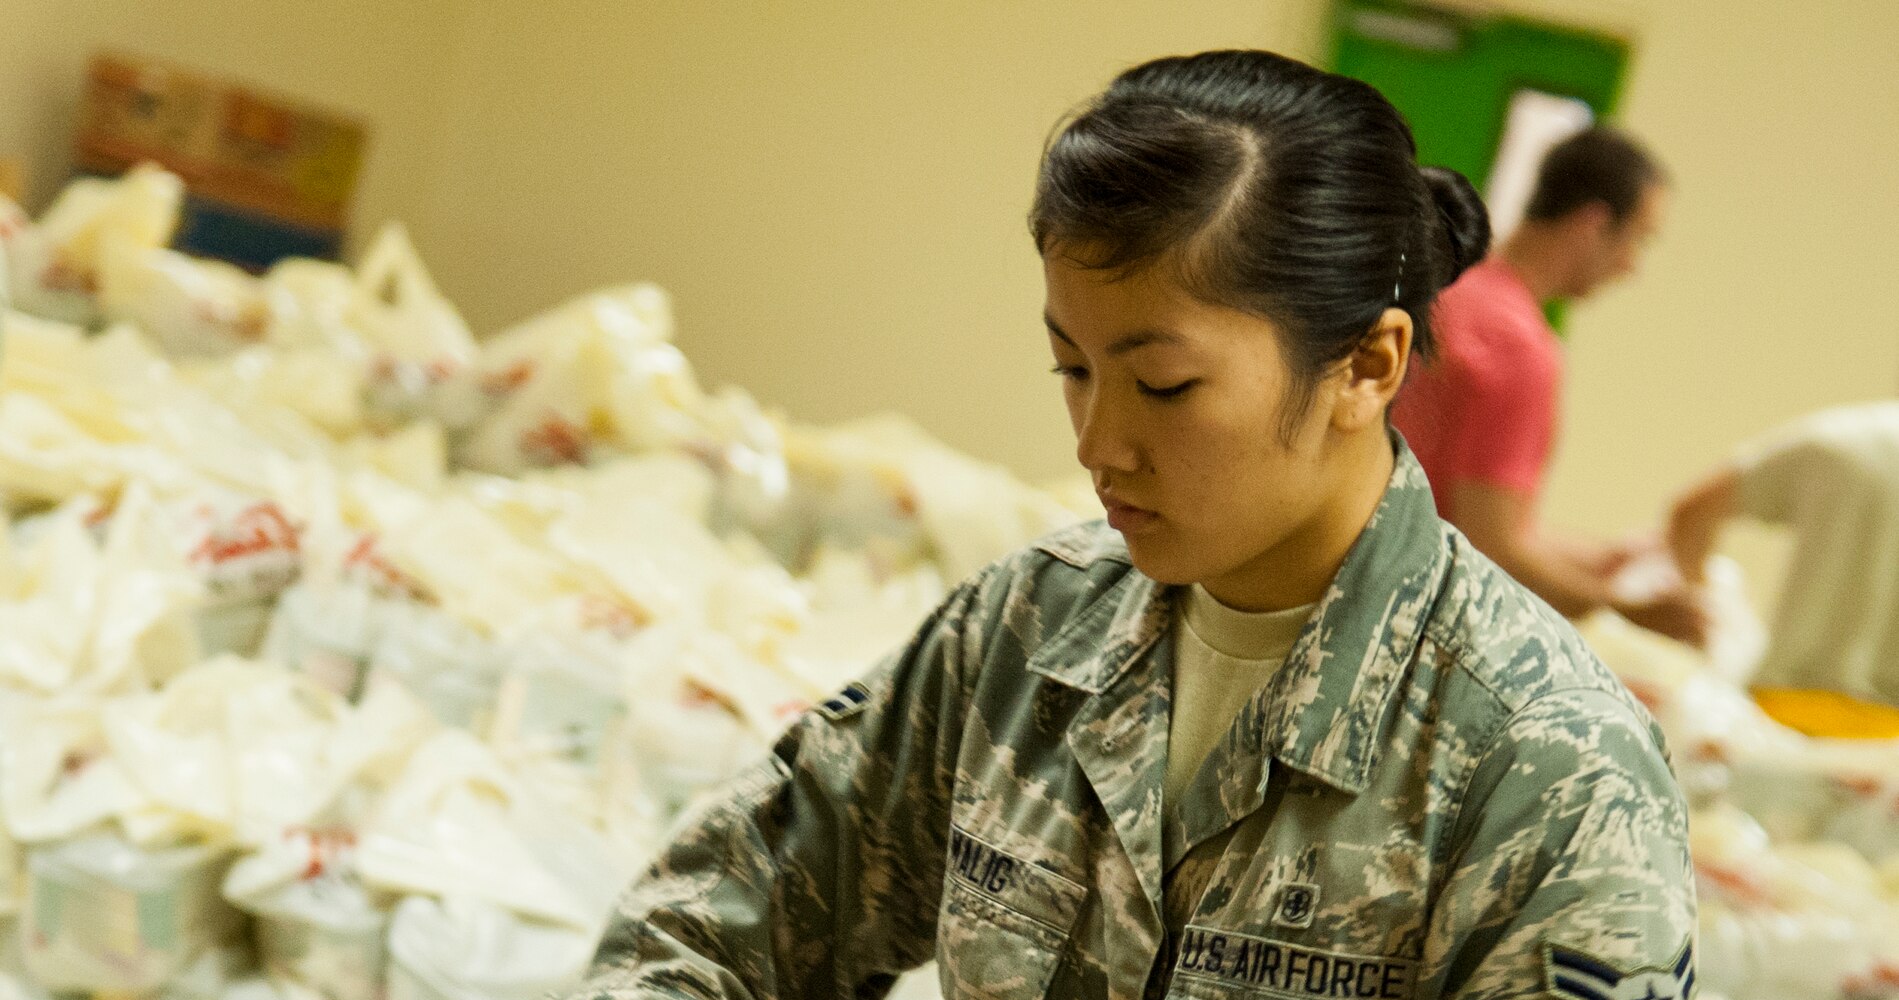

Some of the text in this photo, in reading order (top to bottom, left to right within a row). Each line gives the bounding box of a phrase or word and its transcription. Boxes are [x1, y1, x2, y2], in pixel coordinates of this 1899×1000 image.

[1181, 929, 1406, 1000] U.S. AIR FORCE
